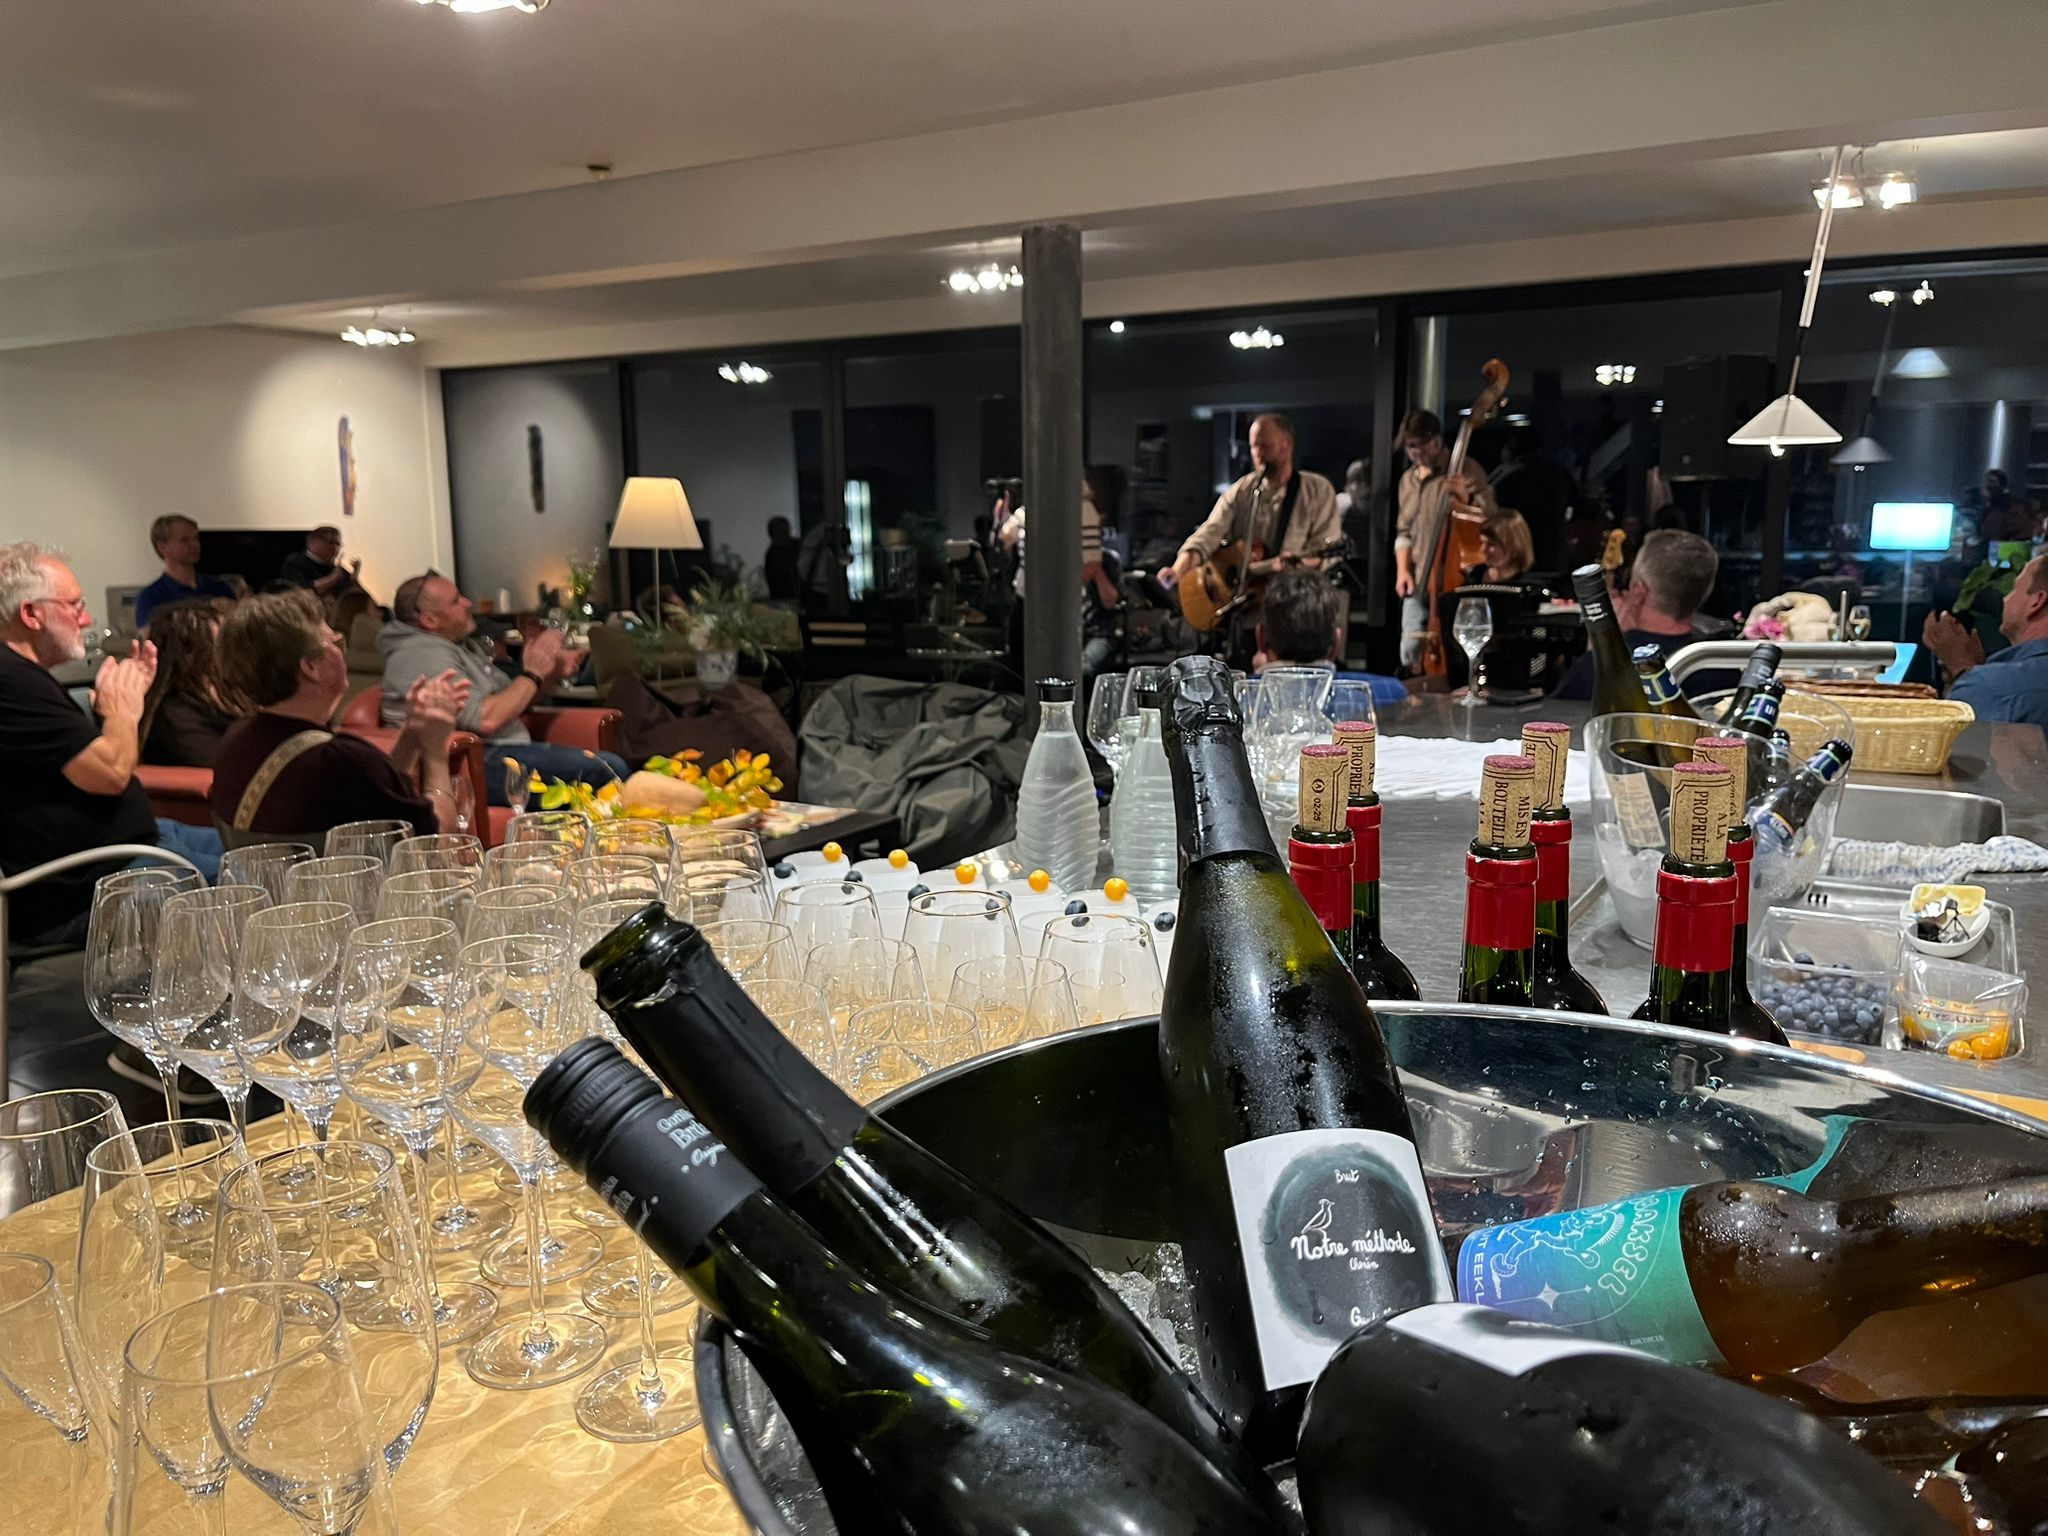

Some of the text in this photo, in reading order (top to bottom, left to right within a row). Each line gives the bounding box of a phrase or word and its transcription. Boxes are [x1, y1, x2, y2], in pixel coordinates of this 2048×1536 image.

[1349, 745, 1364, 797] PROPRIÉT
[1516, 796, 1530, 839] MIS EN
[1291, 1228, 1416, 1260] Notre méthode
[1473, 1252, 1485, 1305] EEKL
